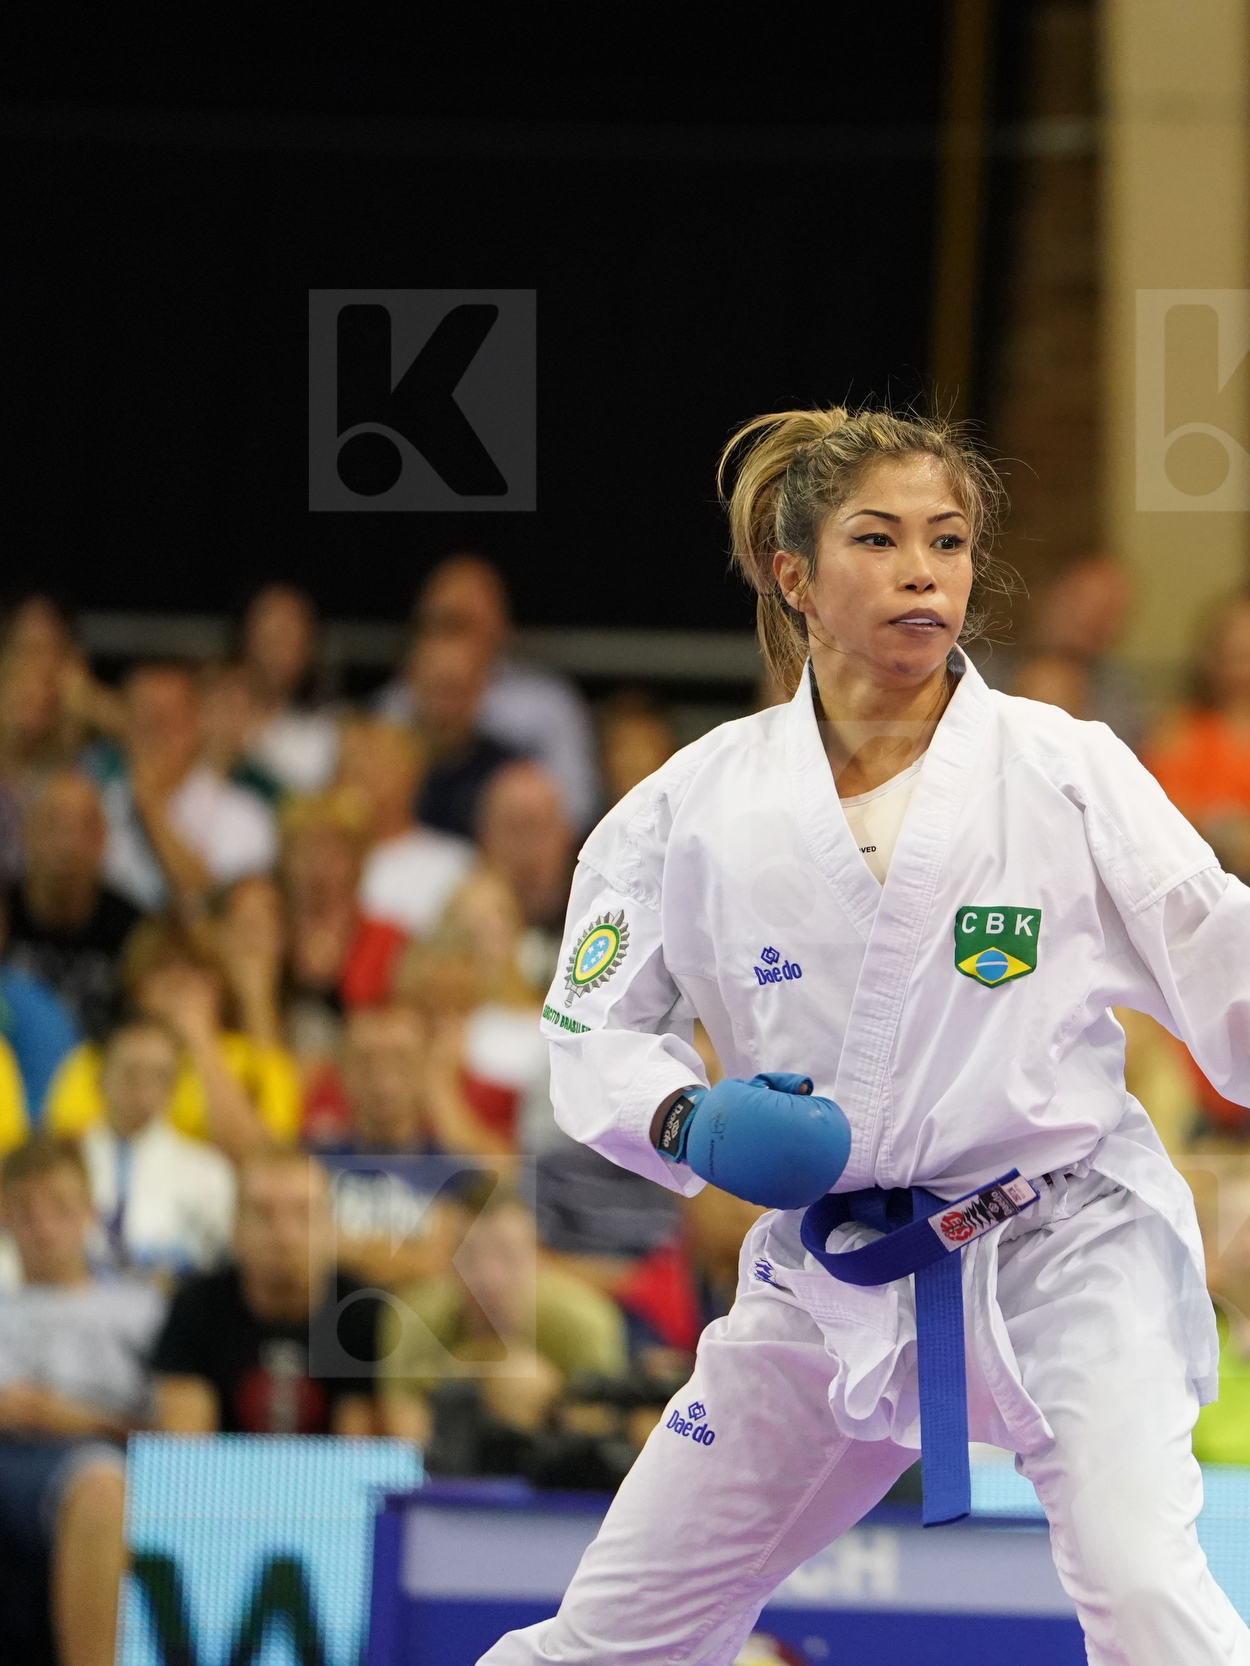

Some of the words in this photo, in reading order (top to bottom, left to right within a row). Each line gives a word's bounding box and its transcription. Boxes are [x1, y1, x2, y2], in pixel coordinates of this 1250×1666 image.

[753, 959, 803, 986] Daedo
[662, 1103, 684, 1148] Daedo
[991, 1191, 1013, 1216] Daedo
[666, 1409, 716, 1447] Daedo
